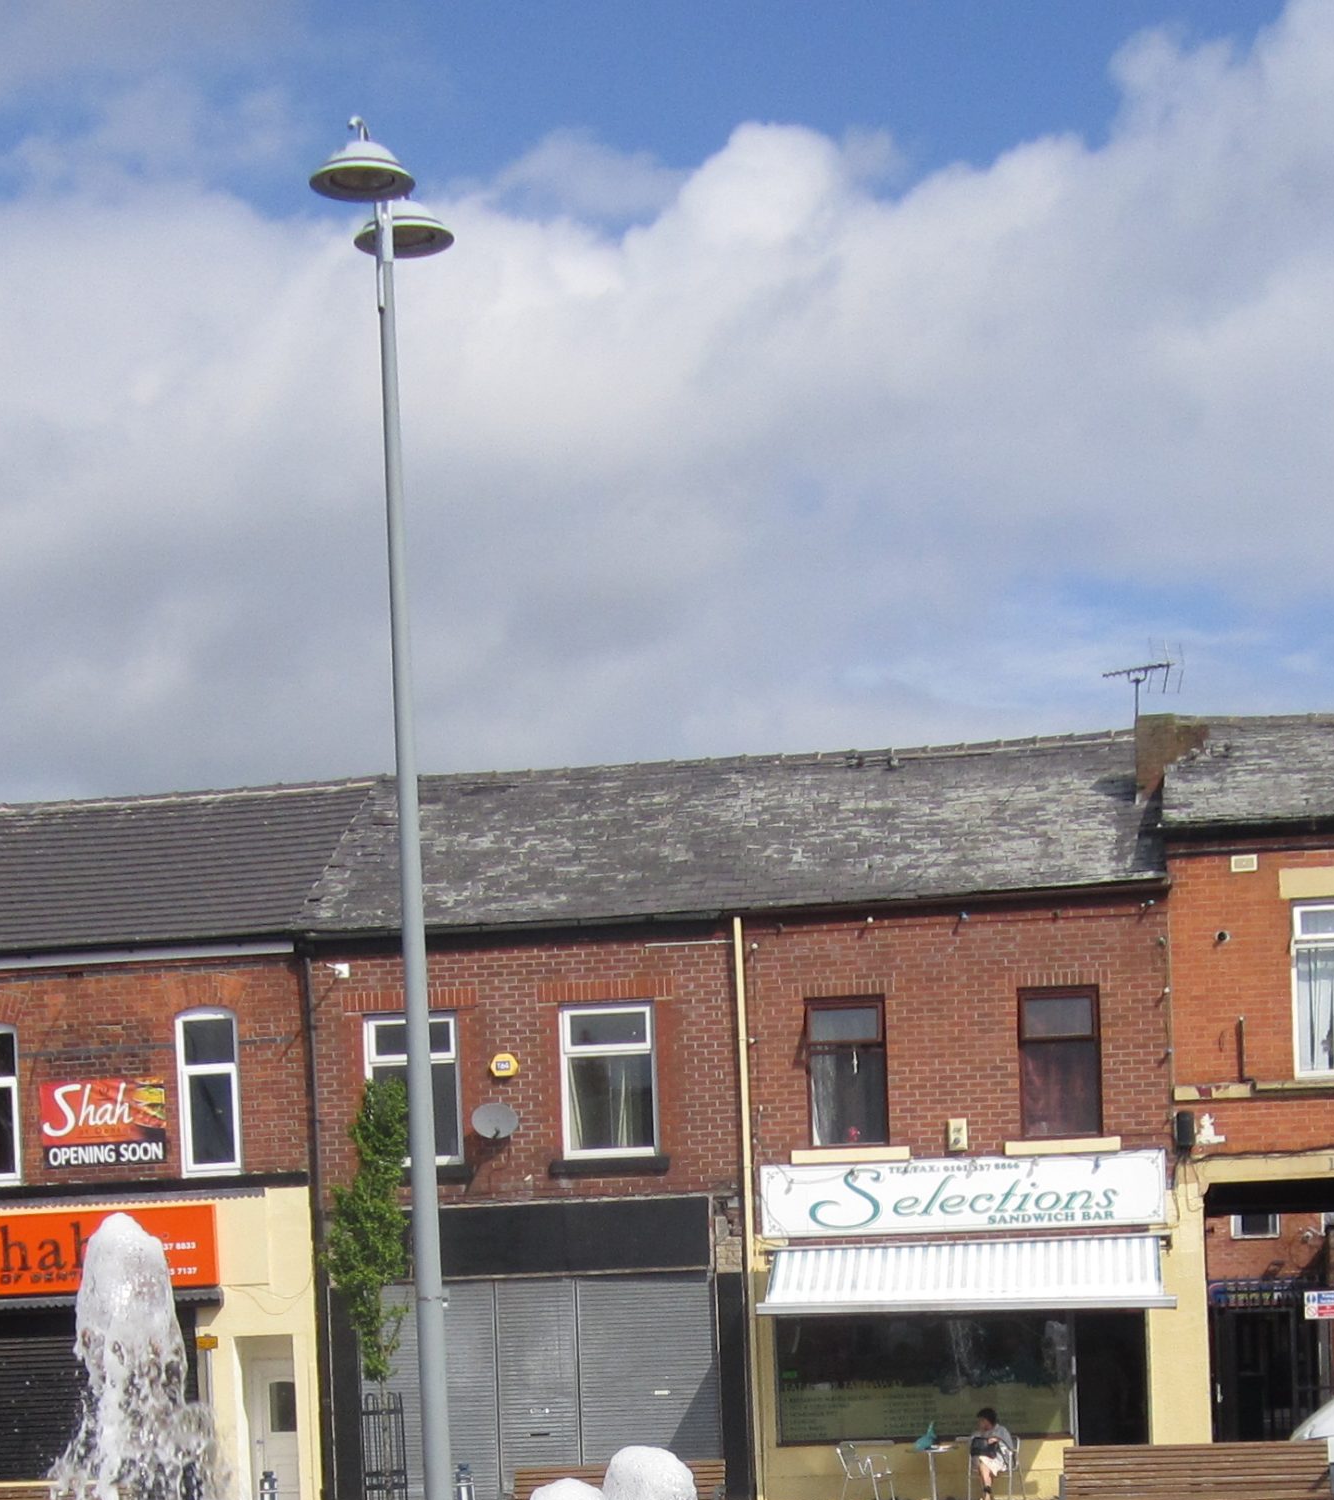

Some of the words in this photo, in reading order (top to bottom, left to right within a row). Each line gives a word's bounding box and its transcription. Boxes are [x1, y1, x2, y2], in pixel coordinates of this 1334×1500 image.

[43, 1082, 134, 1137] Shah
[49, 1144, 116, 1166] OPENING
[120, 1142, 164, 1162] SOON
[809, 1168, 1121, 1230] Selections
[987, 1211, 1077, 1225] SANDWICH
[1081, 1209, 1116, 1222] BAR
